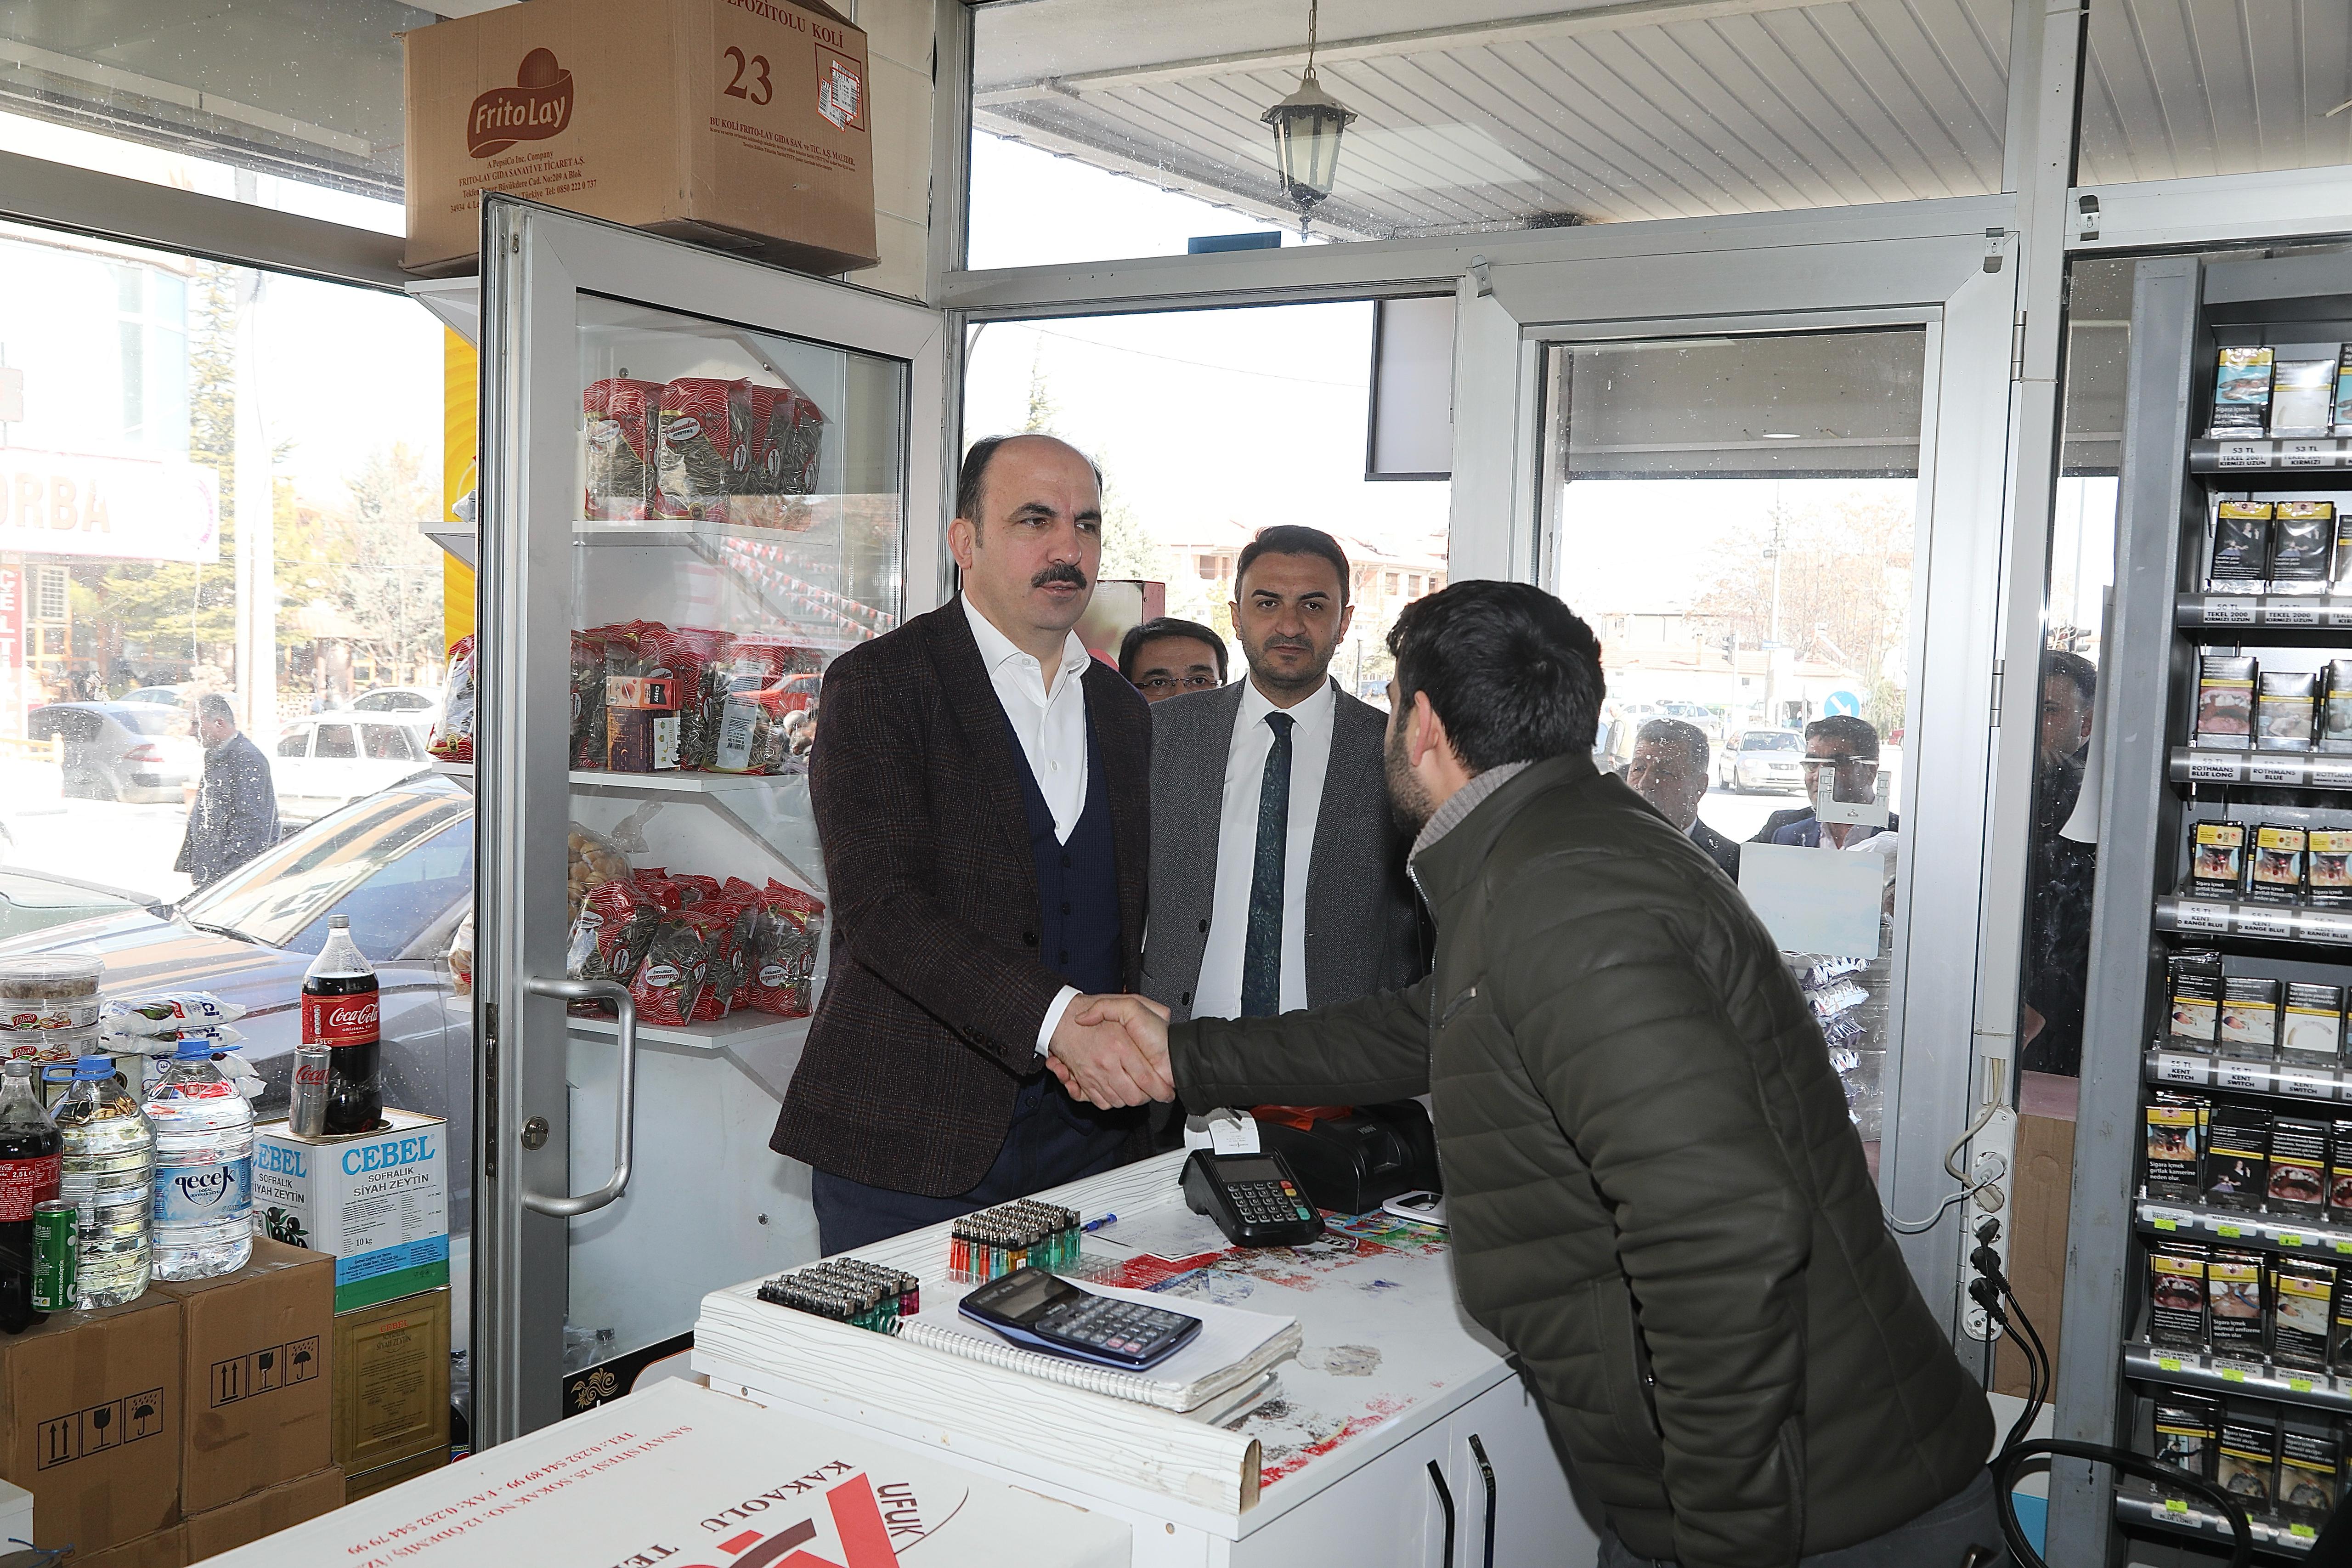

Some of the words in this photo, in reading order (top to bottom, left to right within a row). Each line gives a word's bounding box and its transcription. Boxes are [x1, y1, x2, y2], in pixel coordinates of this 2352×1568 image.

[812, 23, 843, 48] KOLİ
[724, 46, 772, 105] 23
[710, 117, 720, 126] BU
[722, 119, 739, 130] KOLİ
[740, 124, 773, 140] FRITO-LAY
[775, 134, 789, 143] GIDA
[790, 138, 803, 149] SAN.
[493, 157, 514, 168] PepsiCo
[527, 151, 553, 161] Company
[459, 174, 491, 187] FRITO-LAY
[492, 170, 509, 180] GIDA
[509, 164, 533, 176] SANAYİ
[534, 164, 543, 172] VE
[543, 158, 572, 171] TİCARET
[569, 169, 582, 179] Blok
[557, 184, 570, 194] 0850
[571, 182, 581, 191] 222
[587, 179, 597, 188] 737
[0, 472, 111, 533] RBA
[329, 1002, 379, 1027] Coca-Cola
[341, 1135, 435, 1176] CEBEL
[259, 1173, 292, 1189] SOFRALIK
[368, 1166, 414, 1183] SOFRALIK
[254, 1181, 272, 1196] İYAH
[274, 1189, 304, 1204] ZEYTİN
[354, 1183, 386, 1197] SİYAH
[389, 1173, 429, 1189] ZEYTİN
[380, 1320, 408, 1333] CEBEL
[599, 1430, 638, 1449] TEL:
[639, 1425, 693, 1455] SANAYİ
[565, 1444, 602, 1464] 0.232
[592, 1447, 640, 1472] SİTESİ
[525, 1467, 543, 1482] 89
[540, 1459, 567, 1474] 544
[570, 1467, 593, 1480] 25.
[506, 1475, 526, 1490] 99
[514, 1478, 573, 1506] SOKAK
[457, 1489, 497, 1510] FAX:
[700, 1459, 856, 1534] KAKAOLU
[416, 1506, 458, 1528] 0.232
[483, 1502, 516, 1519] NO:
[876, 1482, 926, 1538] UFUK
[388, 1522, 418, 1541] 544
[463, 1516, 482, 1529] 12
[347, 1540, 368, 1557] 99
[368, 1534, 389, 1548] 79
[392, 1524, 464, 1559] ÖDEMİŞ
